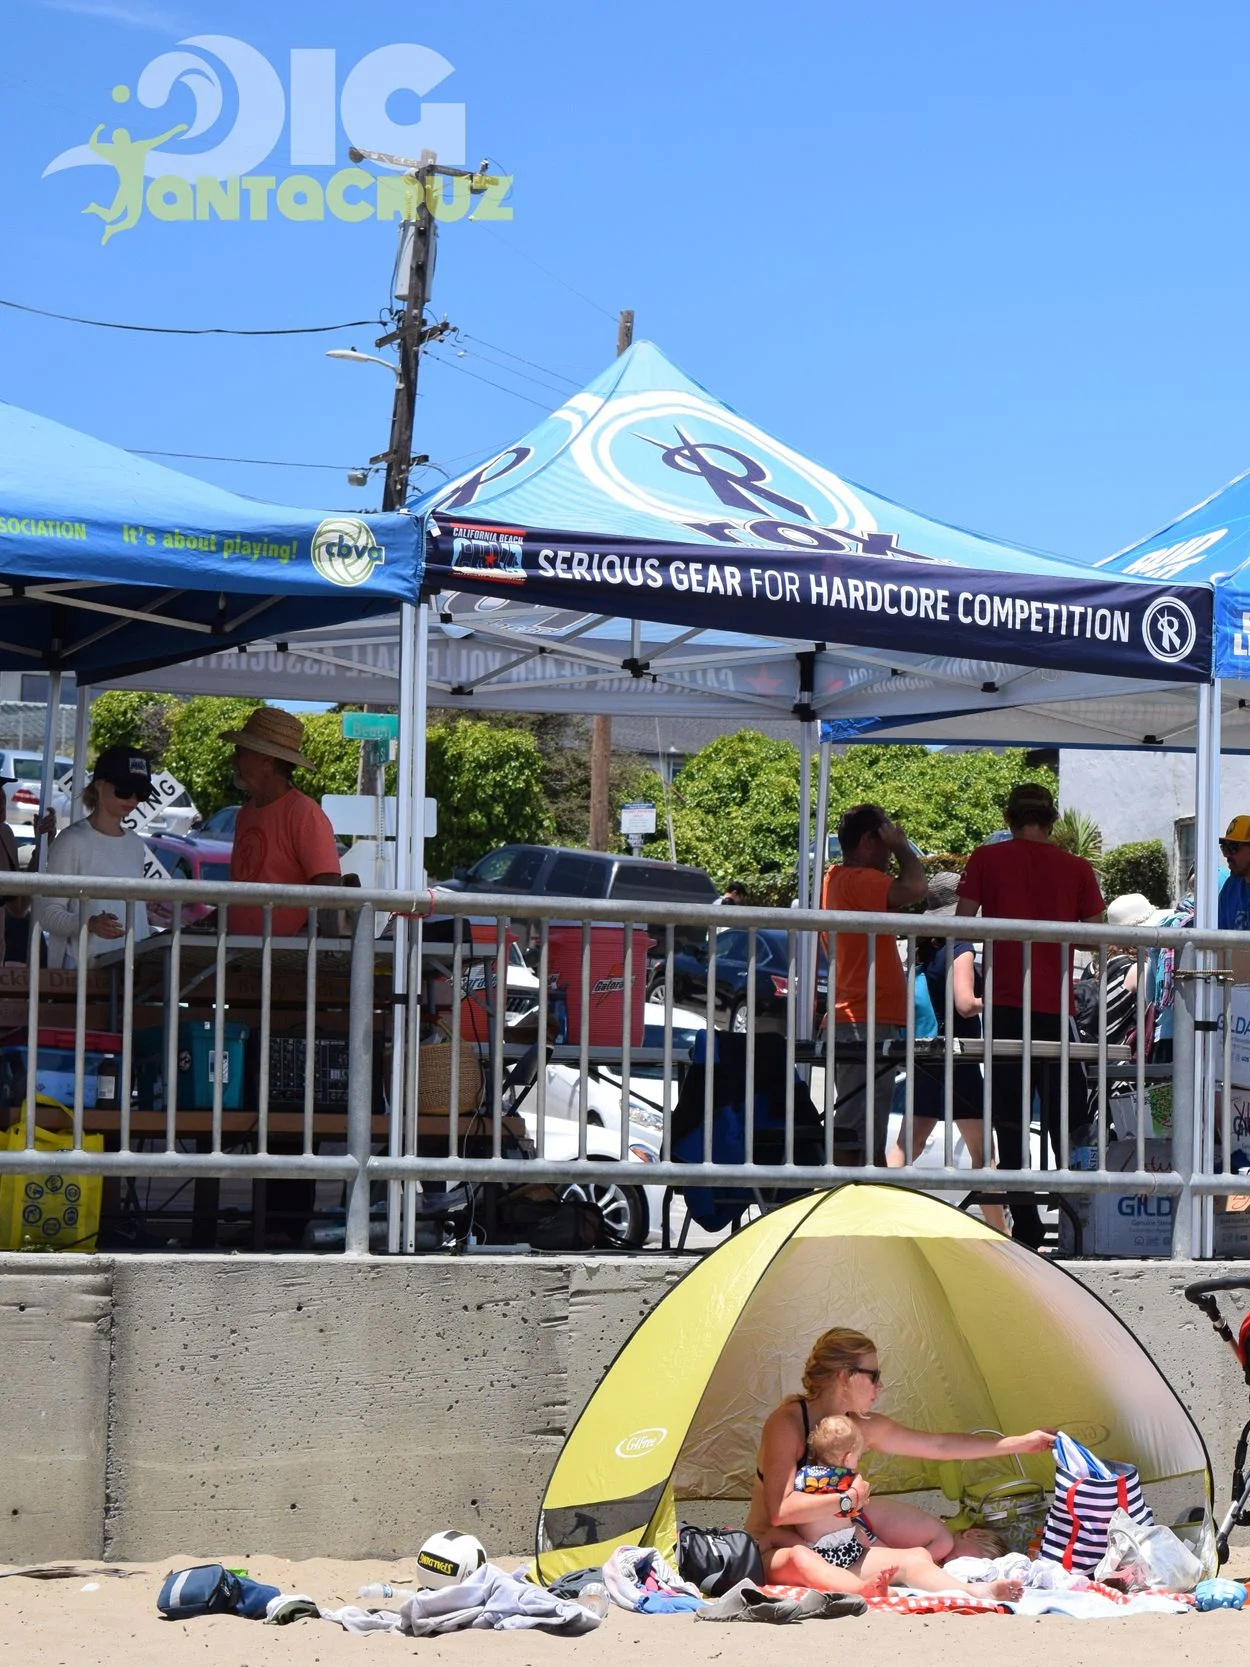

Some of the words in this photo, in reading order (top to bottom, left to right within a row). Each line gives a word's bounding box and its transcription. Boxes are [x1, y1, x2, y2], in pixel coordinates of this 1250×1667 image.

[122, 525, 156, 546] It's
[163, 533, 217, 553] about
[223, 535, 299, 565] playing!
[324, 534, 385, 564] cbva
[453, 527, 497, 543] CALIFORNIA
[498, 533, 524, 545] BEACH
[538, 549, 663, 588] SERIOUS
[669, 560, 743, 597] GEAR
[750, 568, 801, 603] FOR
[809, 574, 950, 622] HARDCORE
[957, 592, 1130, 643] COMPETITION
[353, 722, 391, 738] Beach
[418, 1553, 454, 1575] SPALDING
